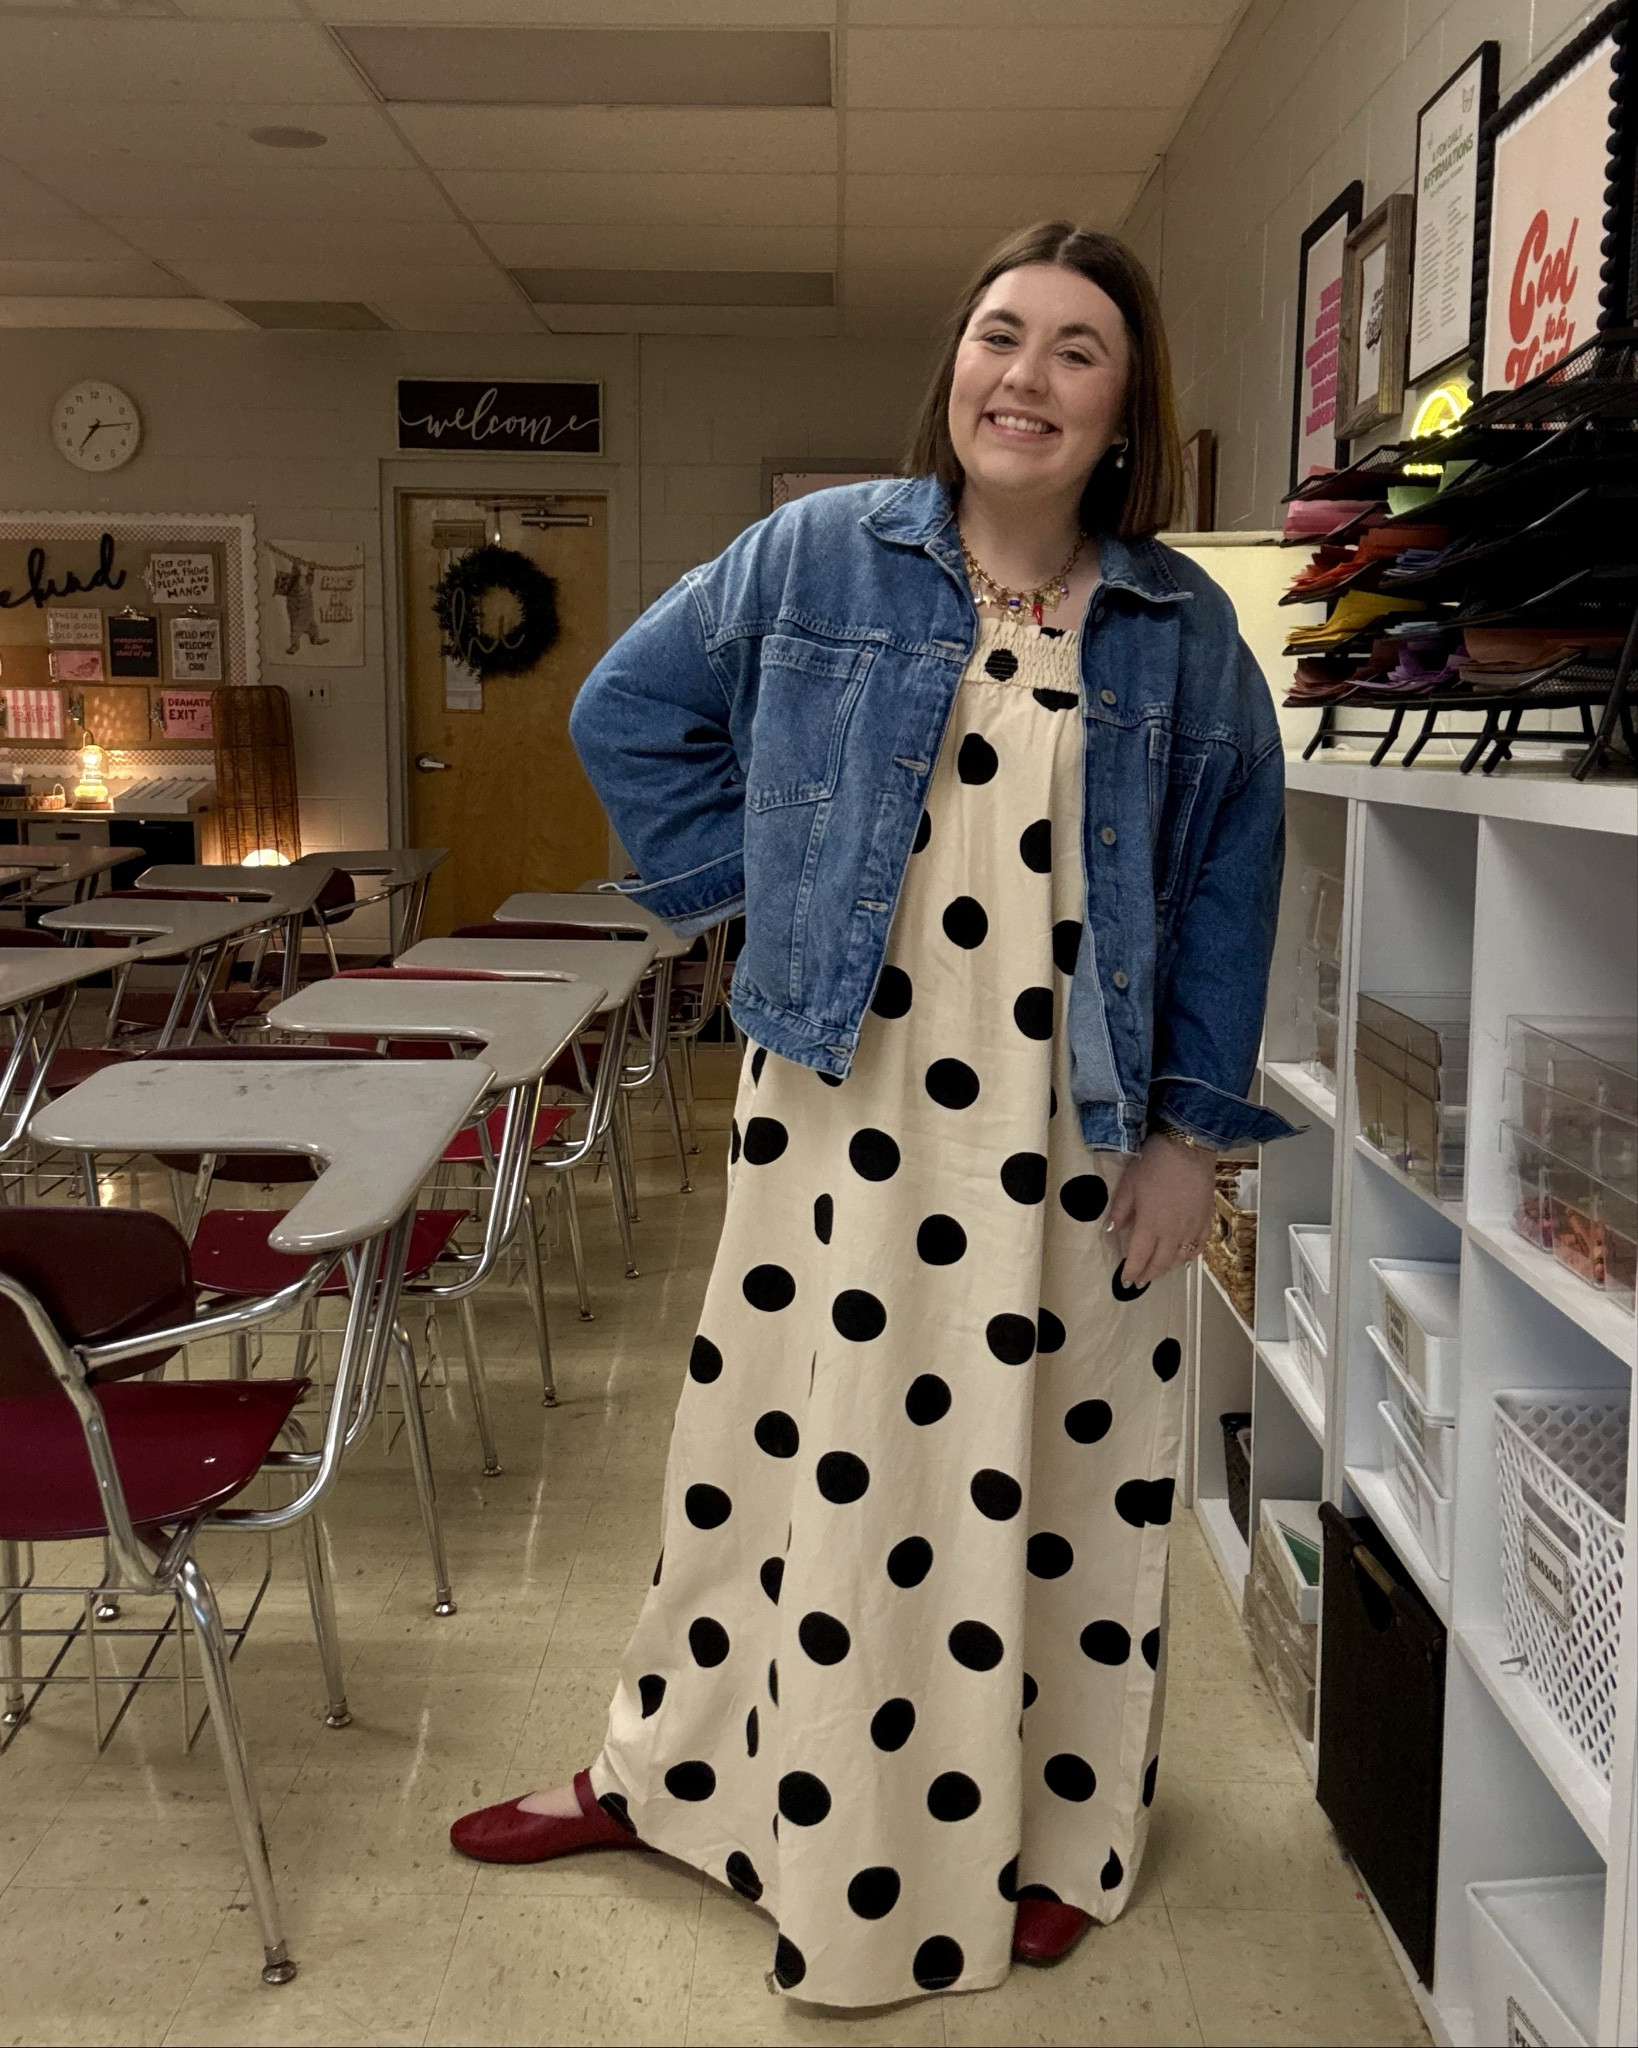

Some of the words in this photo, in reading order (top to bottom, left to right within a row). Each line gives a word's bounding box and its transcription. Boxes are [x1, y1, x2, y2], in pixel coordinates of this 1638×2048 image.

[1423, 132, 1474, 193] AFFIRMATIONS
[1509, 209, 1579, 344] Cool
[75, 395, 83, 403] 11
[90, 390, 99, 400] 12
[65, 406, 75, 416] 10
[119, 407, 126, 415] 2
[400, 387, 599, 445] welcome
[121, 439, 127, 447] 4
[94, 453, 101, 462] 6
[110, 448, 117, 458] 5
[157, 560, 173, 569] GET
[177, 559, 192, 567] OFF
[157, 569, 180, 579] YOUR
[182, 566, 209, 577] PHONE
[191, 576, 210, 585] AND
[320, 576, 355, 591] HANG
[167, 586, 201, 598] HANG
[319, 606, 354, 623] THERE
[175, 631, 197, 639] HELLO
[200, 631, 216, 639] MTV
[179, 641, 213, 650] WELCOME
[185, 652, 194, 660] TO
[197, 652, 208, 660] MY
[189, 663, 205, 671] CRIB
[168, 698, 210, 707] DRAMATI
[169, 709, 197, 720] EXIT
[1529, 1546, 1563, 1595] SCISSORS
